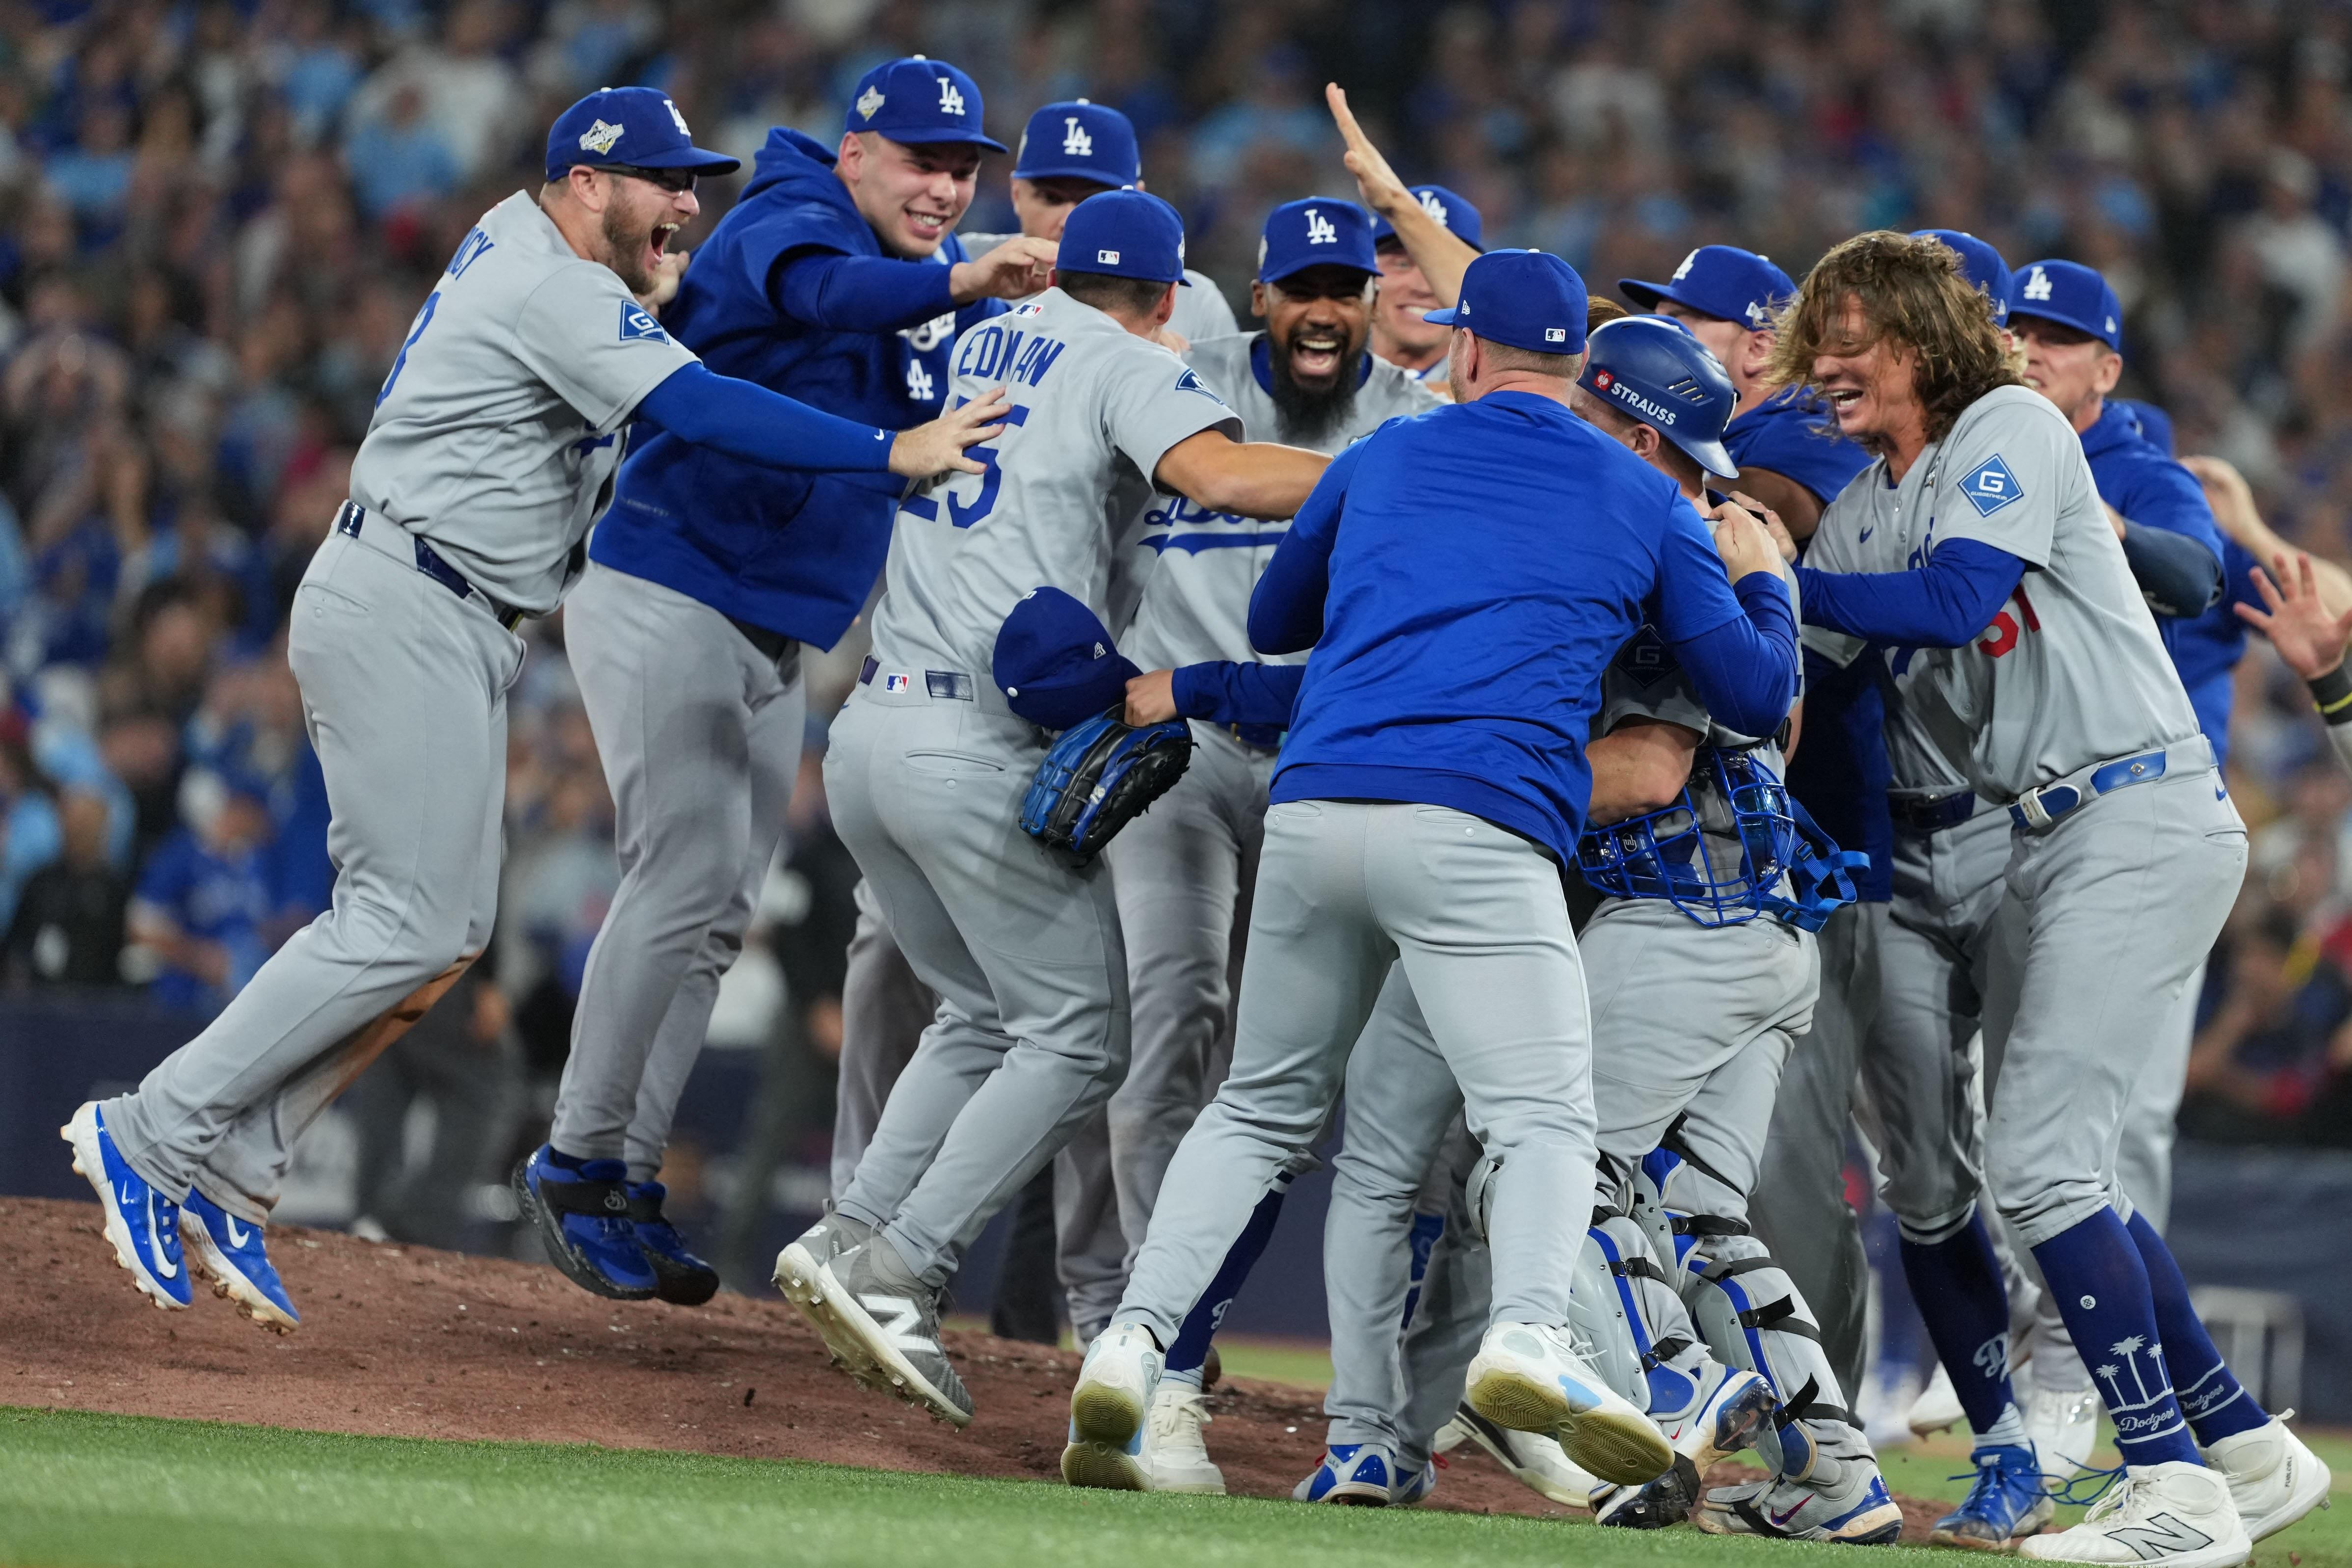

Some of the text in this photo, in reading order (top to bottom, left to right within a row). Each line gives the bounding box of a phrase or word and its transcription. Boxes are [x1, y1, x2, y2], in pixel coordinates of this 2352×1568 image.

[937, 77, 965, 116] LA
[1062, 117, 1092, 156] LA
[1304, 209, 1338, 244] LA
[2023, 266, 2053, 301] LA
[628, 312, 654, 330] G
[1611, 382, 1676, 425] STRAUSS
[1978, 471, 2006, 493] G
[1635, 644, 1661, 664] G
[2023, 795, 2039, 820] 31
[2120, 1408, 2175, 1432] Dodgers
